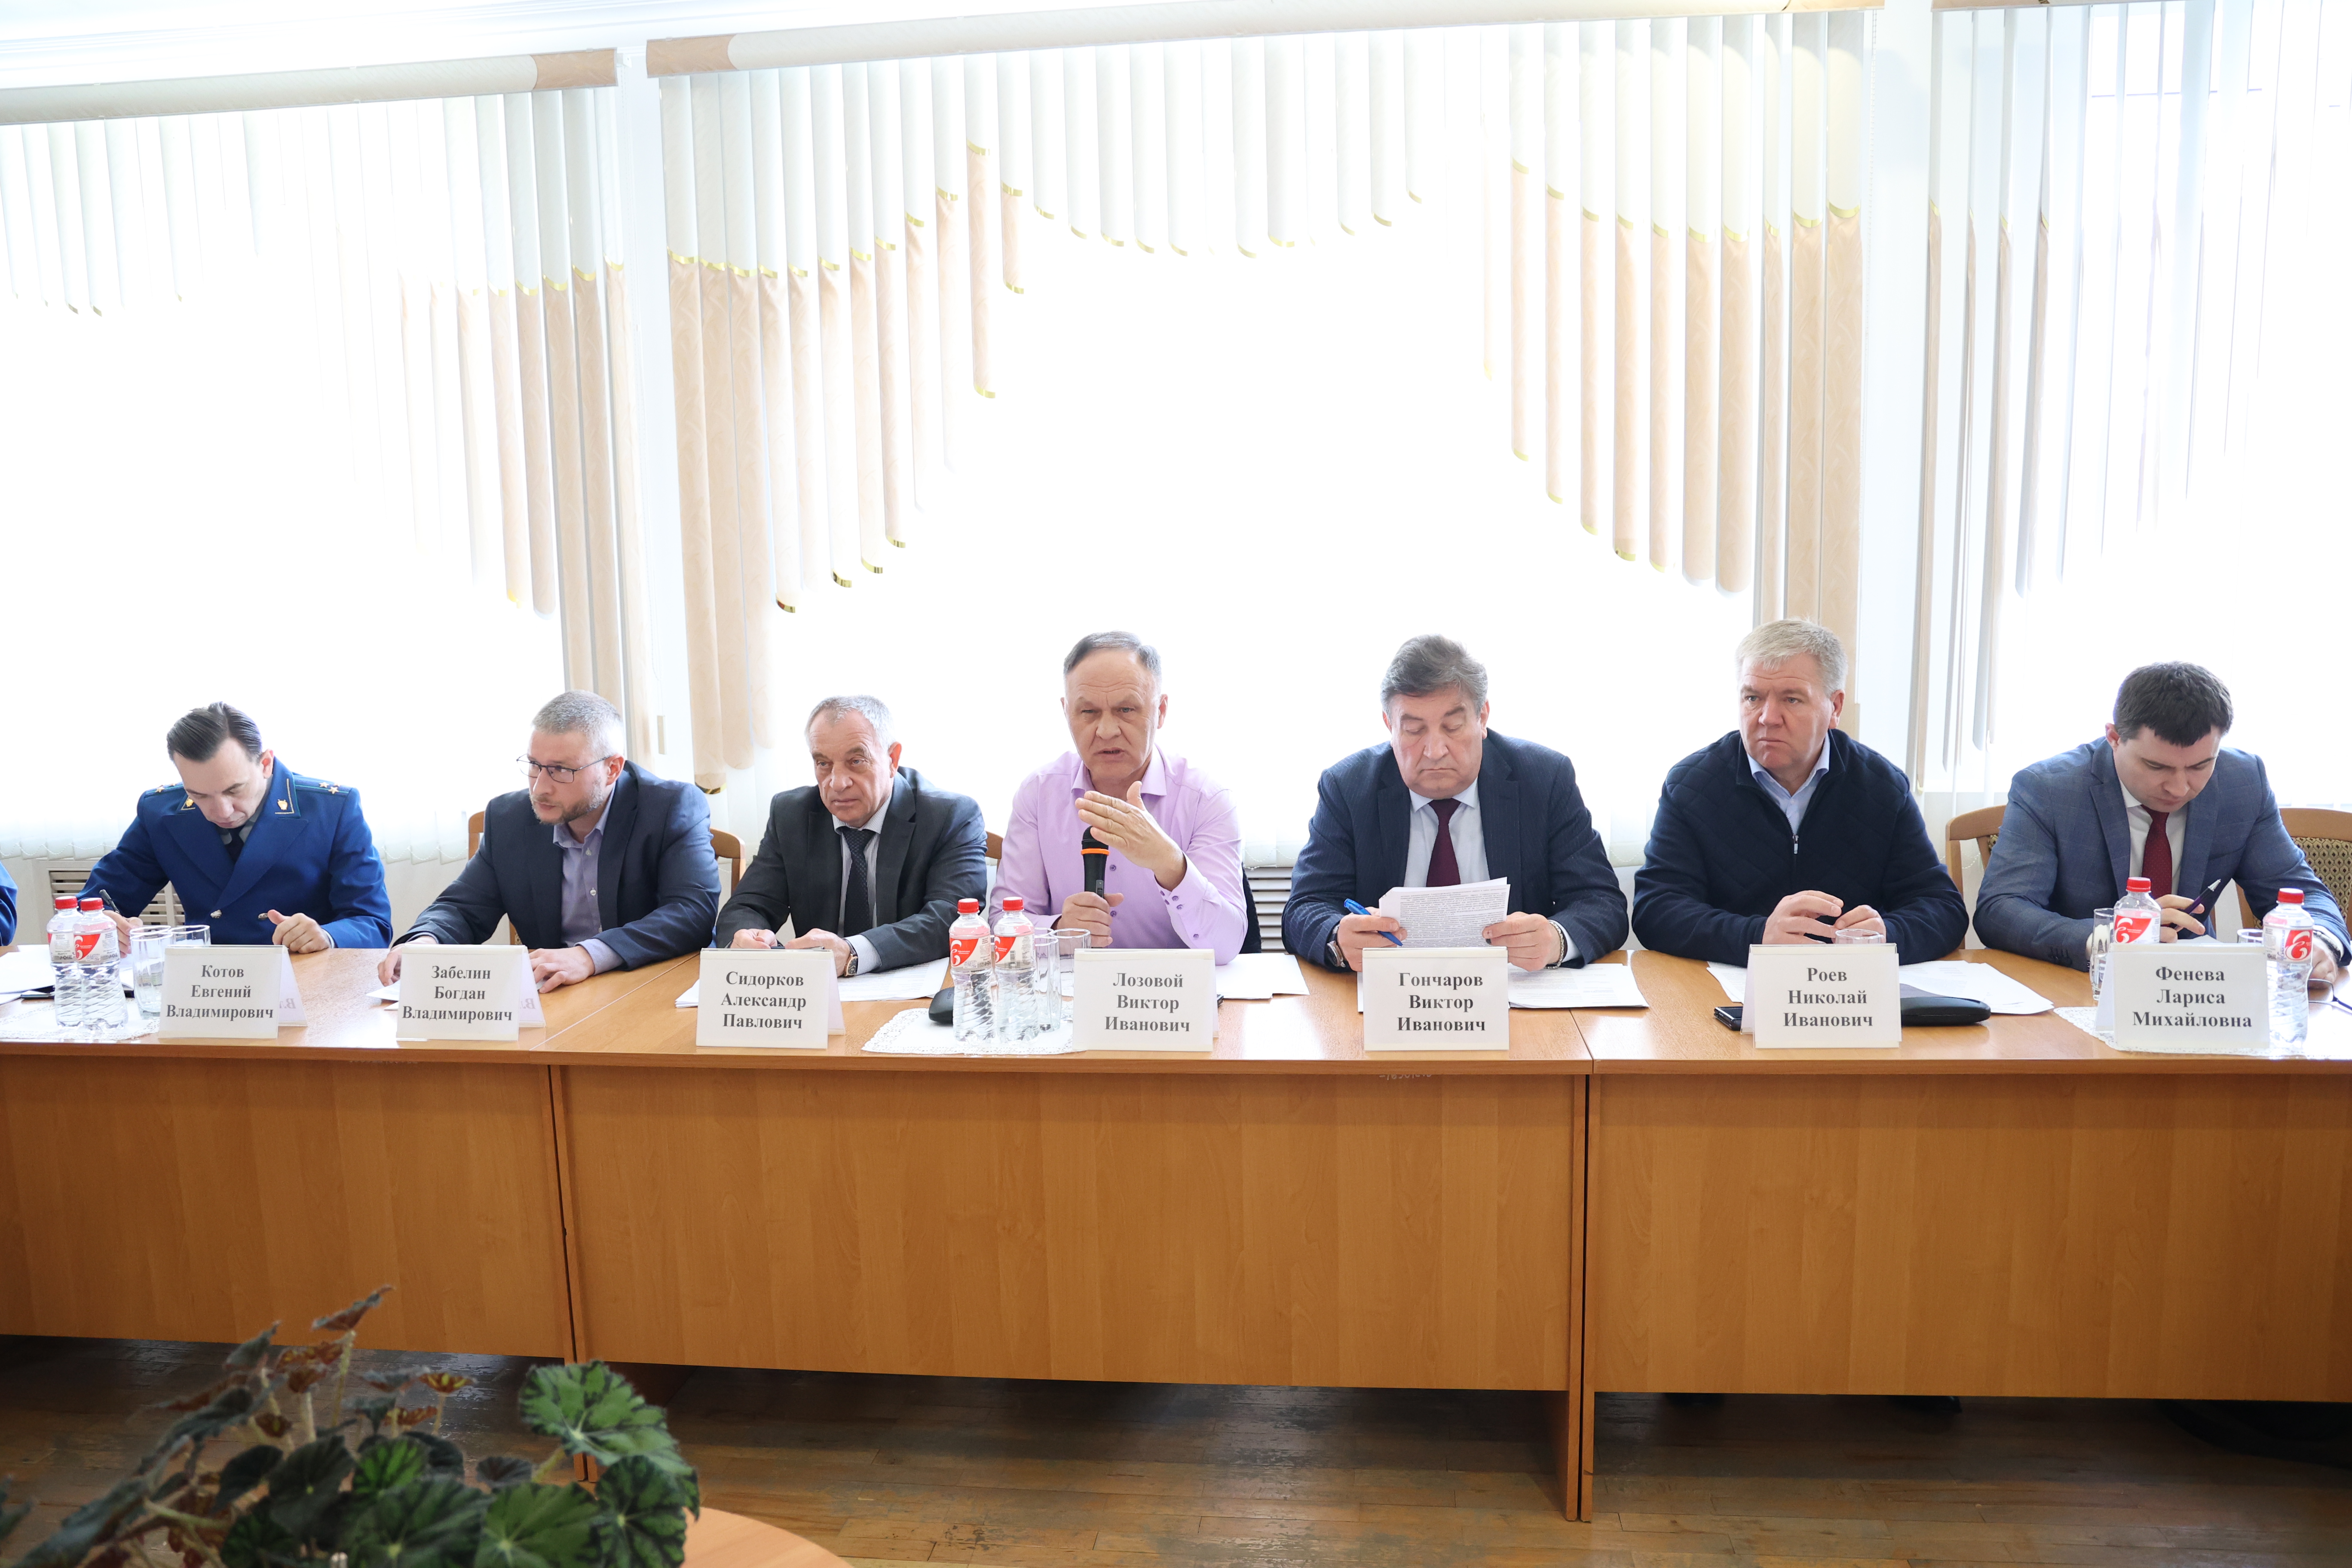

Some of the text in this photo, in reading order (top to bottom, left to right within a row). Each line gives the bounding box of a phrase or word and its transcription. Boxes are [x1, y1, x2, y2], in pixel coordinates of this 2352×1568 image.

[202, 965, 244, 978] Котов
[431, 965, 491, 979] Забелин
[1807, 968, 1847, 982] Роев
[2156, 966, 2225, 981] Фенева
[726, 971, 804, 989] Сидорков
[1113, 973, 1183, 987] Лозовой
[1399, 973, 1483, 990] Гончаров
[191, 985, 251, 998] Евгений
[434, 986, 486, 1001] Богдан
[1788, 990, 1867, 1004] Николай
[2156, 989, 2226, 1008] Лариса
[720, 992, 806, 1011] Александр
[1117, 995, 1179, 1014] Виктор
[1409, 995, 1473, 1013] Виктор
[166, 1004, 273, 1021] Владимирович
[402, 1006, 512, 1024] Владимирович
[1783, 1013, 1873, 1026] Иванович
[2132, 1011, 2252, 1027] Михайловна
[723, 1014, 802, 1029] Павлович
[1105, 1016, 1190, 1032] Иванович
[1397, 1017, 1485, 1031] Иванович
